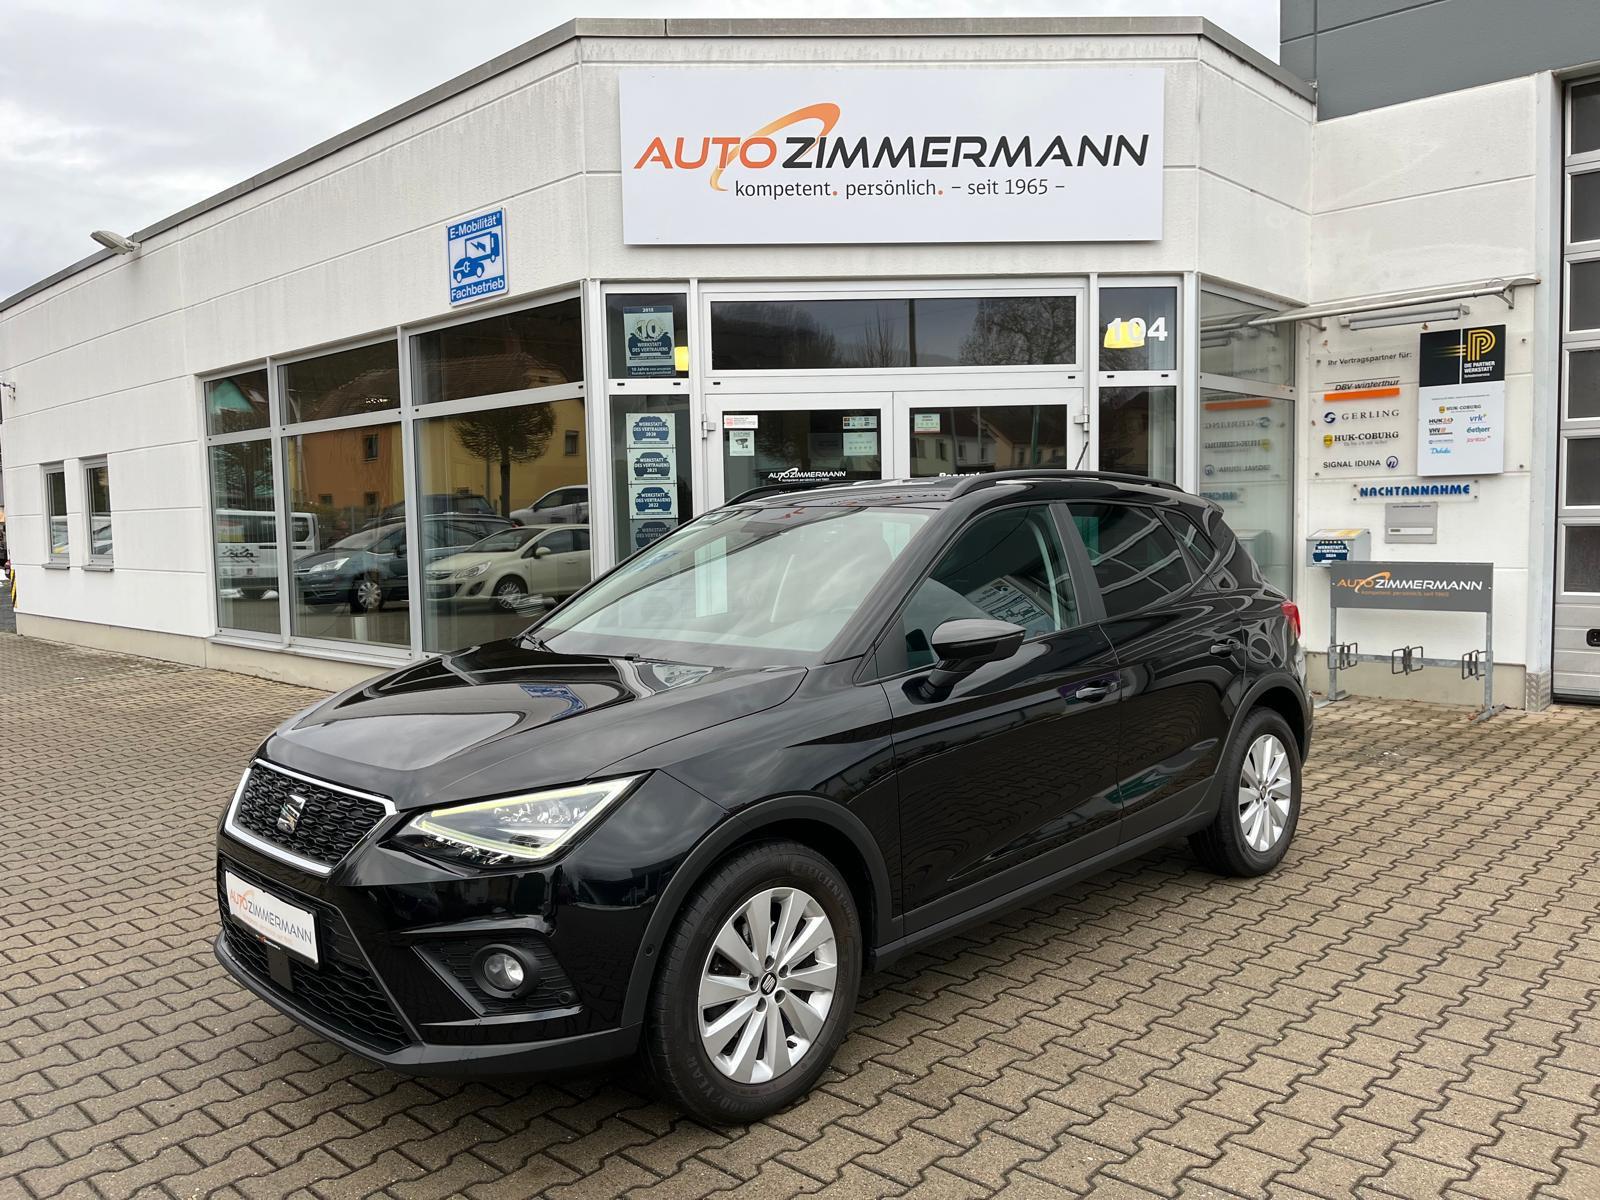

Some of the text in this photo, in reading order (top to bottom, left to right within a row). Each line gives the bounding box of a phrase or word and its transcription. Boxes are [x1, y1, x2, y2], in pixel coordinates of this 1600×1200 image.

[967, 179, 999, 195] seit
[1004, 178, 1048, 195] 1965
[451, 277, 504, 300] Fachbetrieb
[1107, 316, 1168, 342] 104
[1339, 353, 1397, 365] Vertragspartner
[1341, 409, 1400, 421] GERLING
[1334, 430, 1399, 442] HUK-COBURG
[1322, 459, 1381, 469] SIGNAL IDUNA
[1360, 484, 1470, 497] NACHTANNAHME
